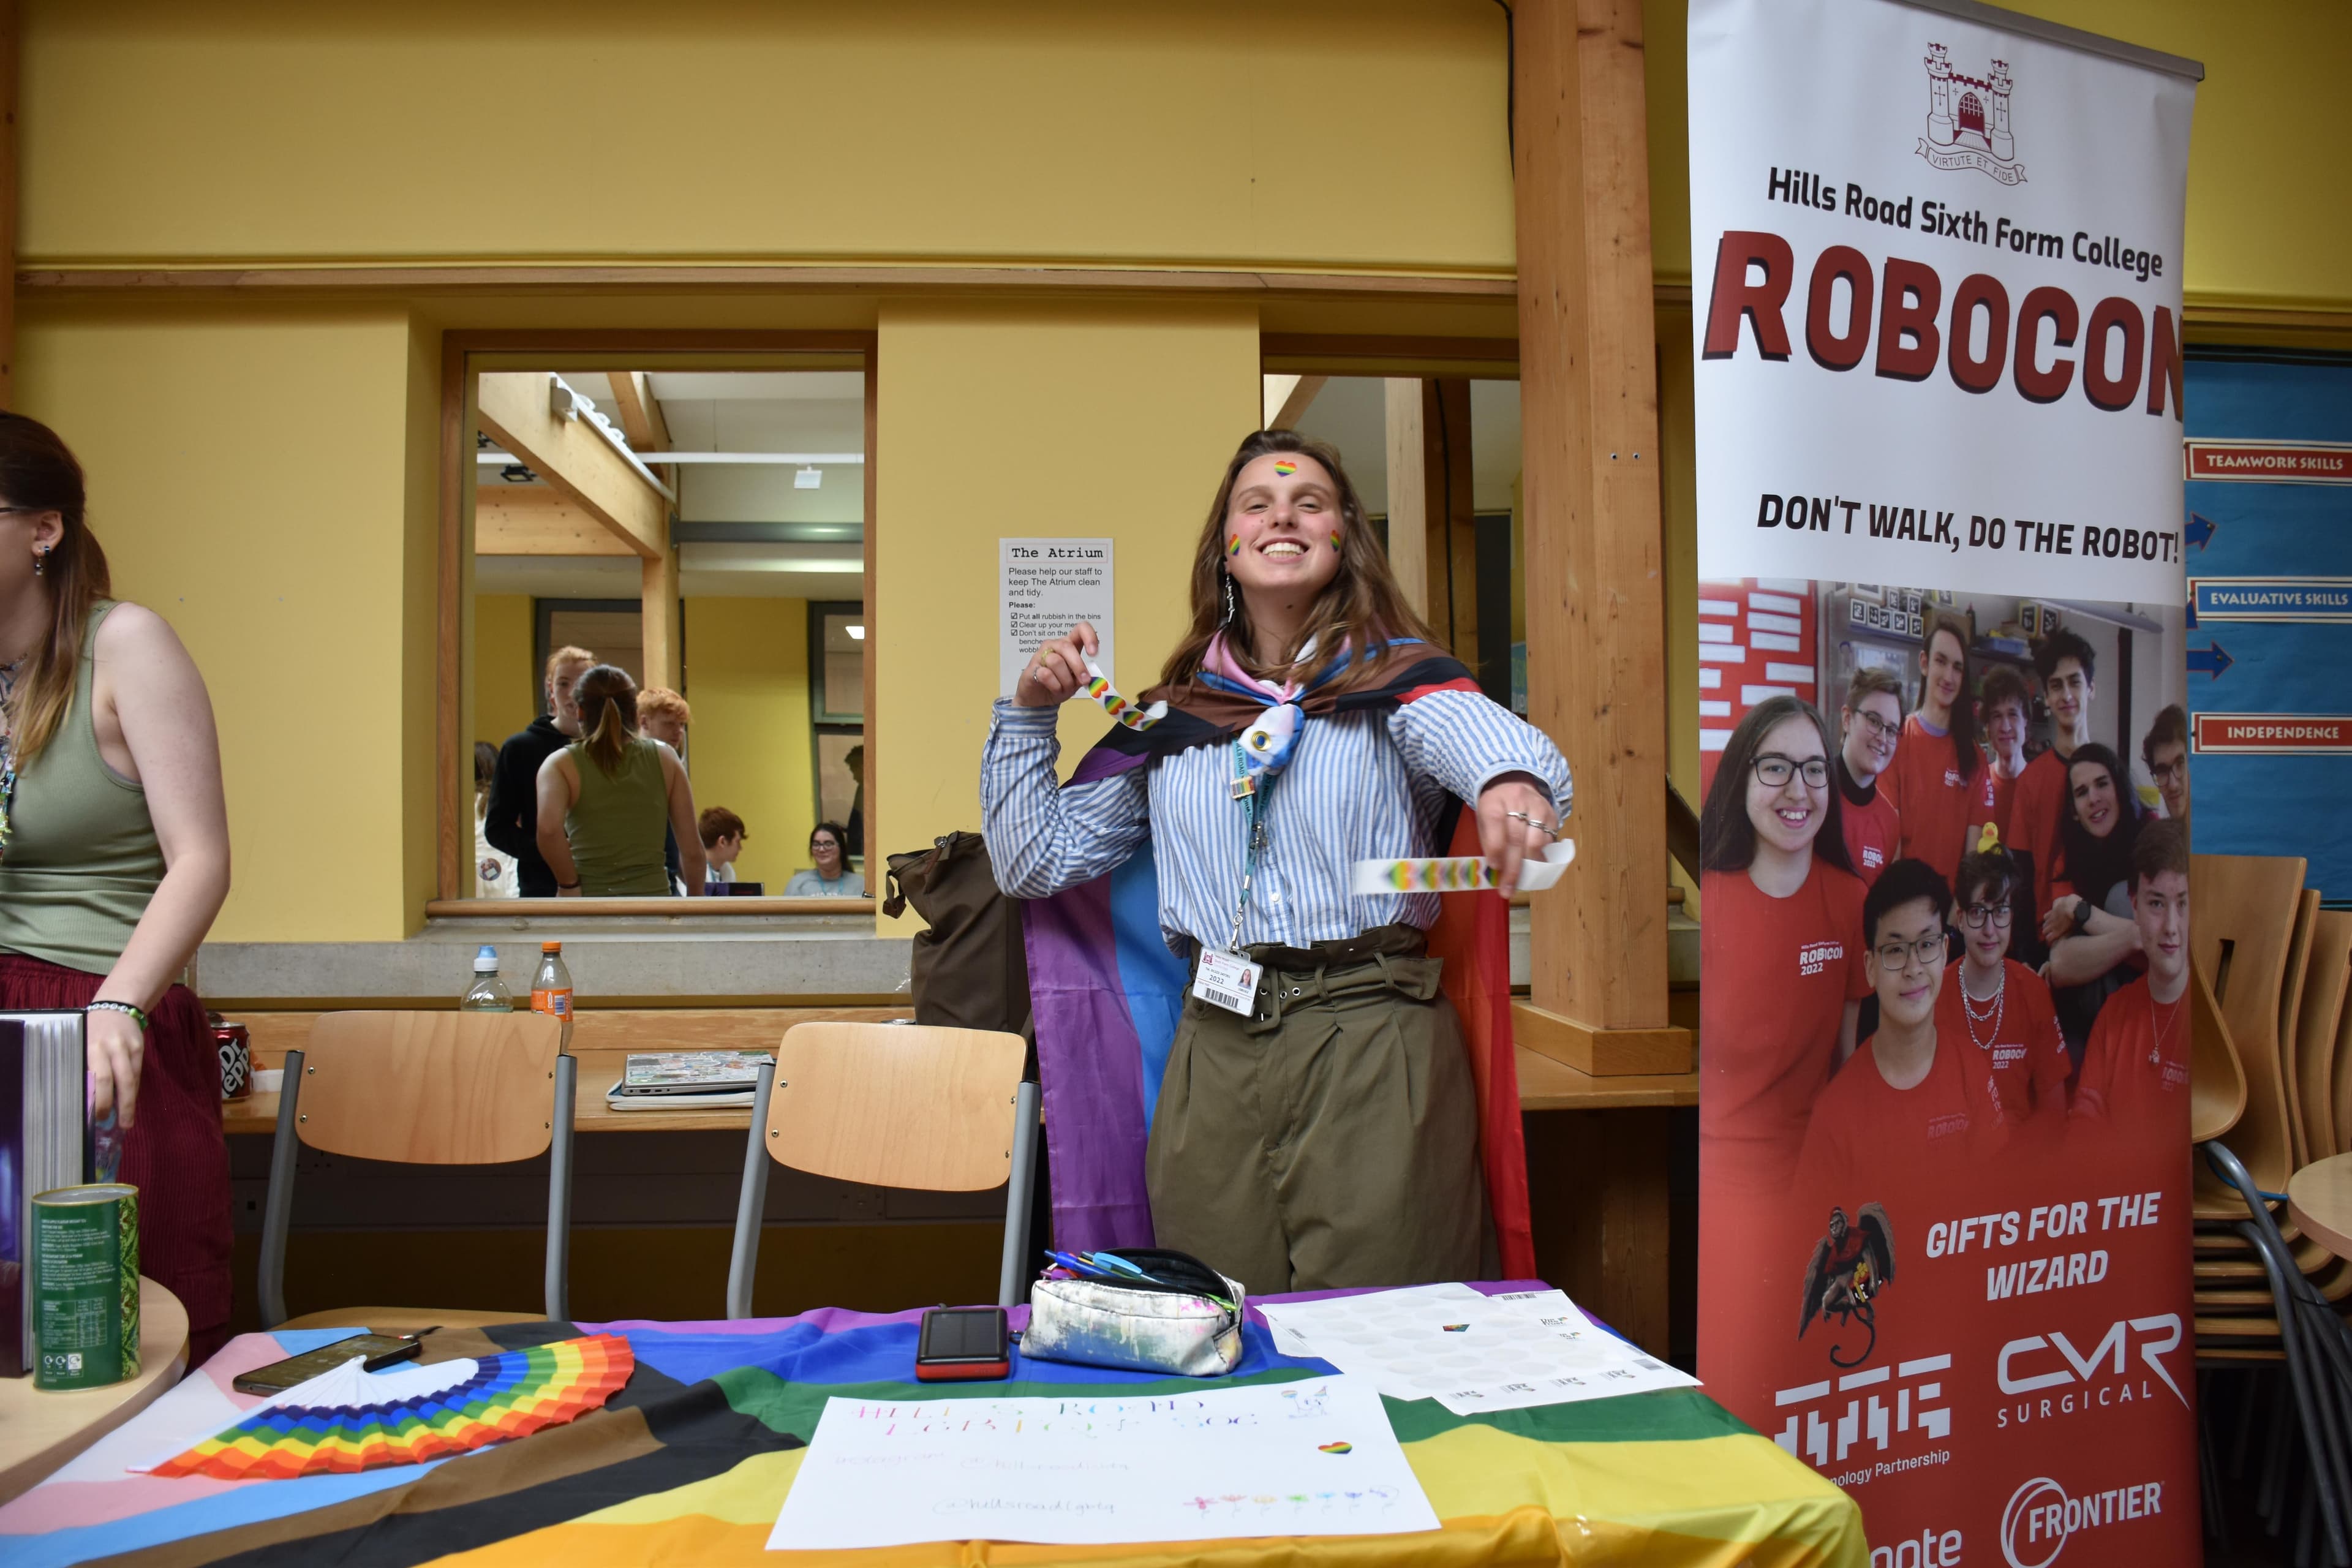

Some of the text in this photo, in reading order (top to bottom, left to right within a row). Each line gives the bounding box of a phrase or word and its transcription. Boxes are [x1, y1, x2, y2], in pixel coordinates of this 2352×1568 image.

[1932, 154, 2014, 182] VIRTUTE ET FIDE
[1768, 167, 2163, 283] Hills Road Sixth Form College
[1702, 230, 2183, 424] ROBOCON
[2206, 454, 2343, 470] TEAMWORK SKILLS
[1757, 493, 2179, 564] DON'T WALK, DO THE ROBOT!
[1011, 546, 1104, 558] The Atrium
[1009, 567, 1037, 575] Please
[1039, 567, 1057, 577] help
[1074, 567, 1093, 575] staff
[1009, 578, 1029, 587] keep
[1027, 588, 1044, 598] tidy.
[2211, 592, 2348, 606] EVALUATIVE SKILLS
[2228, 726, 2339, 739] INDEPENDENCE
[1800, 946, 1843, 965] ROBCO
[1209, 974, 1224, 985] 2022
[1801, 962, 1823, 976] 2022
[218, 1038, 241, 1074] Dr
[1992, 1061, 2009, 1069] 2022
[1926, 1191, 2162, 1259] GIFTS FOR THE
[1985, 1249, 2109, 1302] WIZARD
[1997, 1312, 2191, 1411] CMR
[1997, 1380, 2152, 1428] SURGICAL
[1830, 1449, 1950, 1486] nology Partnership
[2029, 1482, 2162, 1543] FRONTIER
